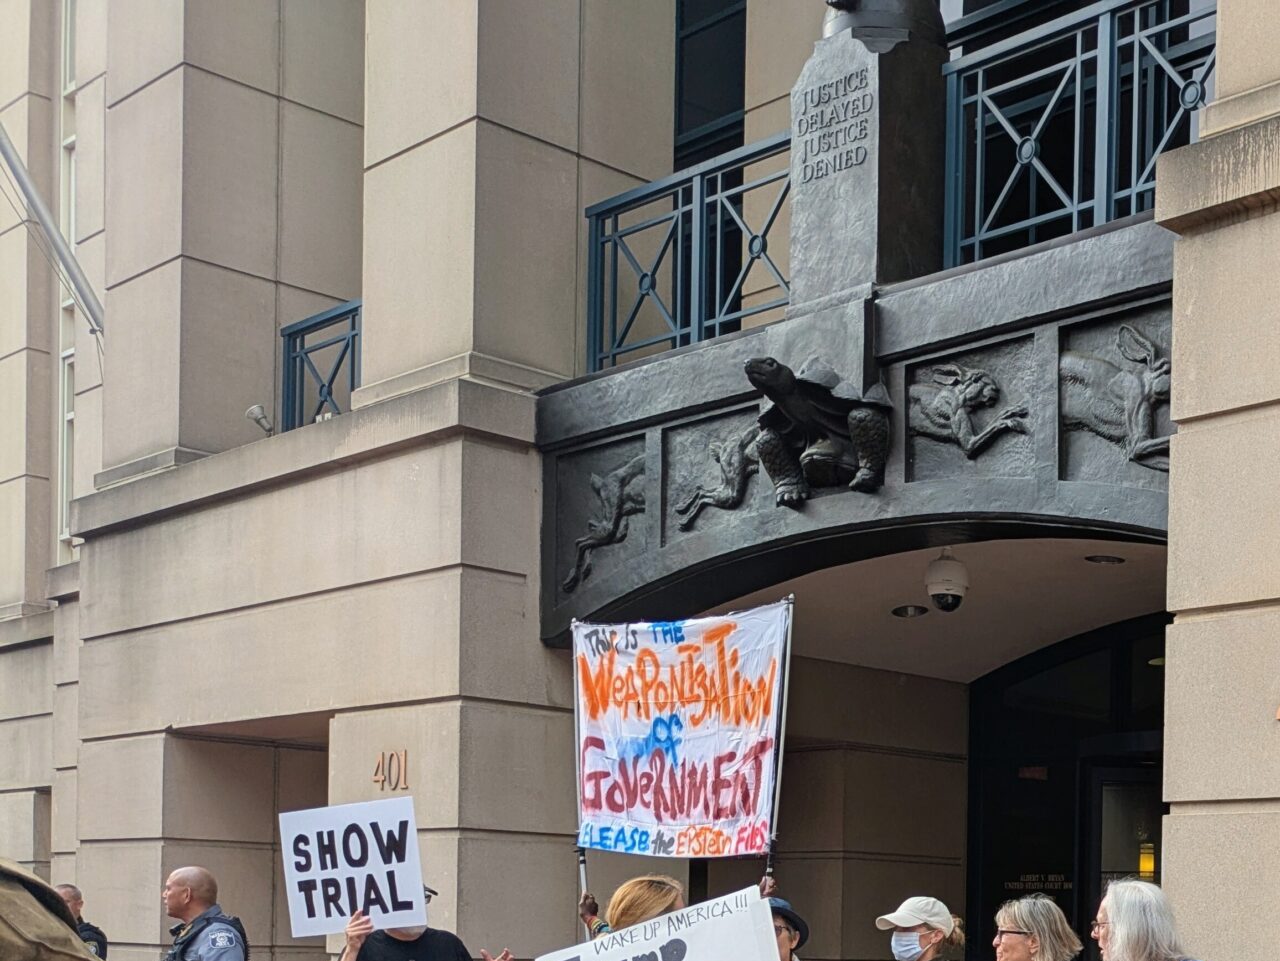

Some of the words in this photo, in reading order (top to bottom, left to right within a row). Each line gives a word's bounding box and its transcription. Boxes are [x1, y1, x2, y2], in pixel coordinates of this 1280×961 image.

[802, 67, 869, 116] JUSTICE
[797, 93, 874, 138] DELAYED
[802, 118, 868, 164] JUSTICE
[802, 146, 867, 184] DENIED
[372, 749, 409, 791] 401
[293, 819, 409, 873] SHOW
[651, 829, 675, 855] the
[297, 870, 413, 919] TRIAL
[594, 929, 639, 955] WAKE
[643, 920, 661, 942] UP
